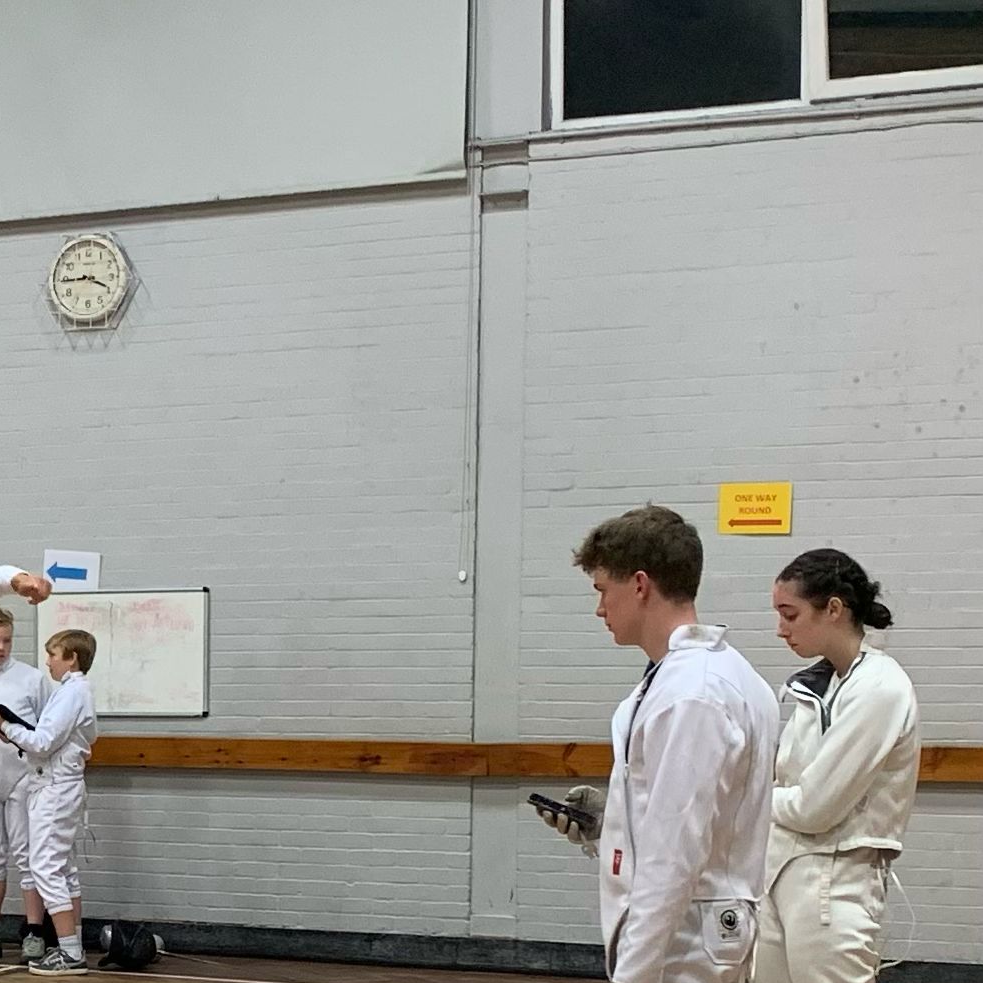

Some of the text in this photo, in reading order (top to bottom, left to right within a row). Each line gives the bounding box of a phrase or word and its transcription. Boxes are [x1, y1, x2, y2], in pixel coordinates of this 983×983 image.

[734, 494, 777, 502] ONE WAY
[739, 506, 772, 514] ROUND
